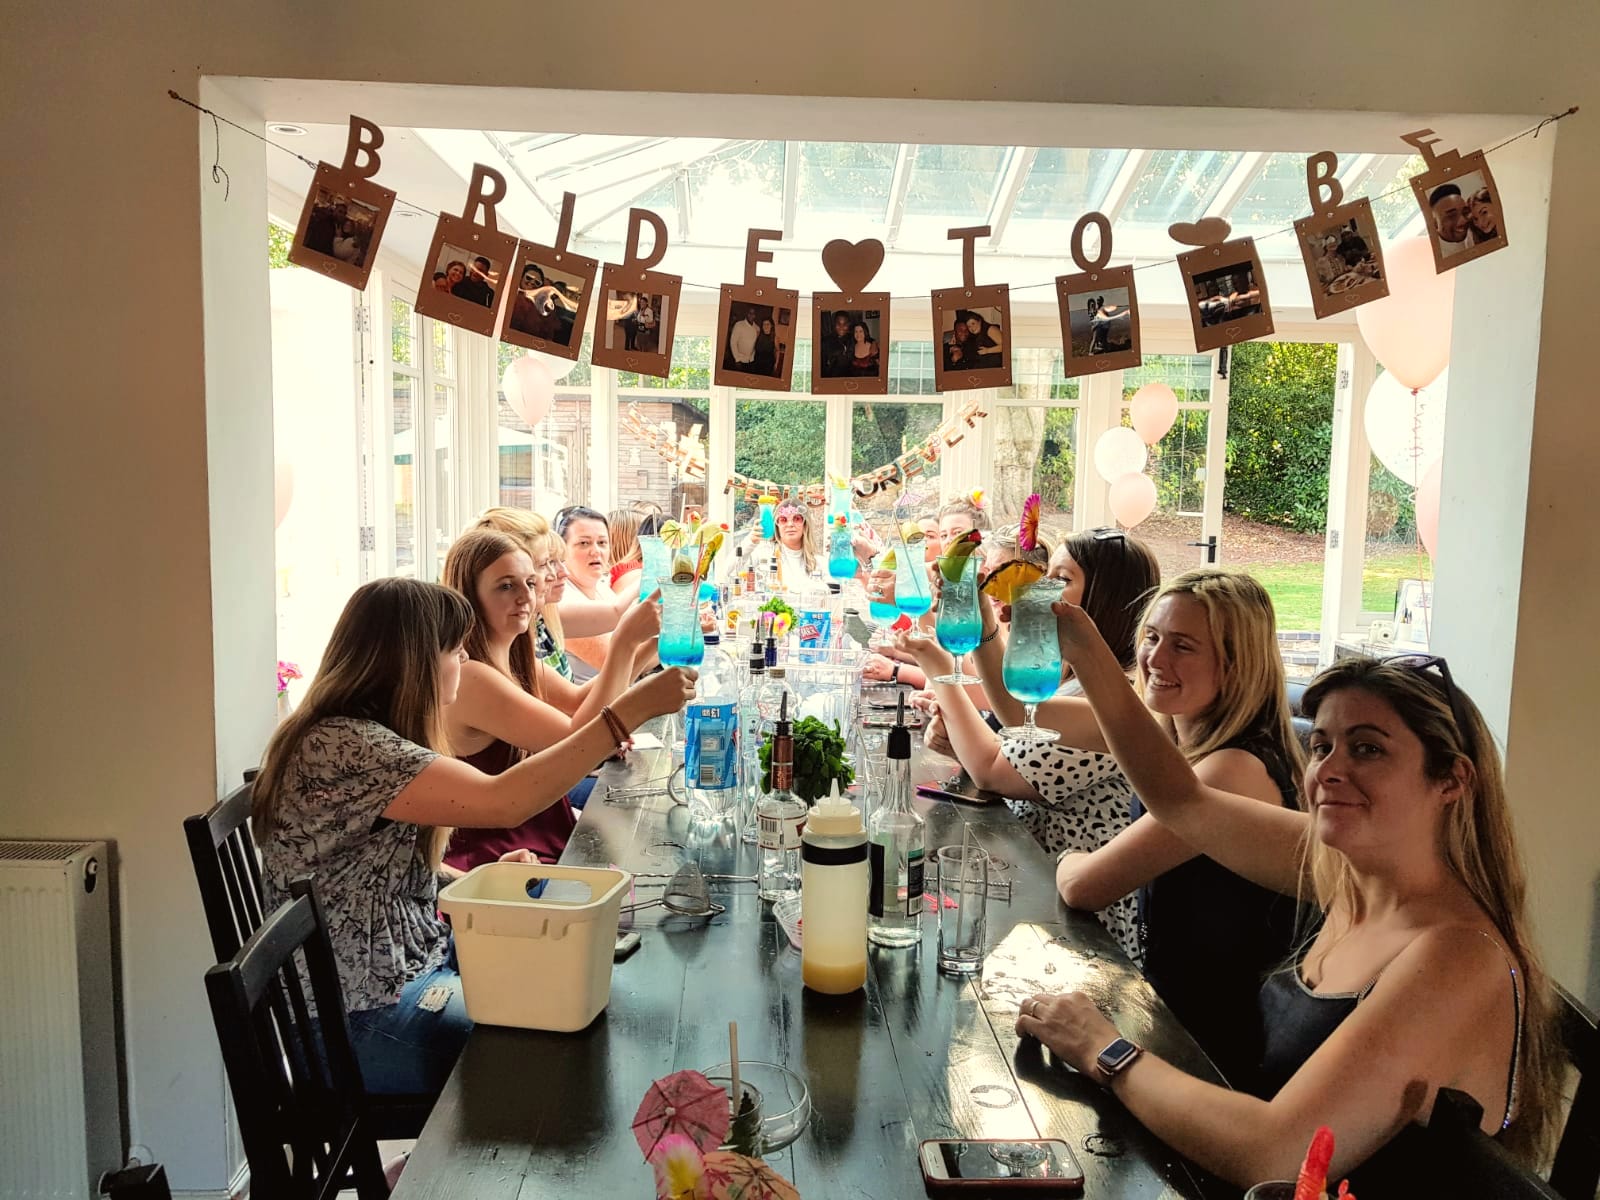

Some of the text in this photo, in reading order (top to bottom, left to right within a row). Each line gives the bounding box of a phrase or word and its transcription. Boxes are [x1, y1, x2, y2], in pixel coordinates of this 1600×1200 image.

[341, 114, 1462, 288] BRIDE TO BE
[850, 400, 988, 499] OREVER
